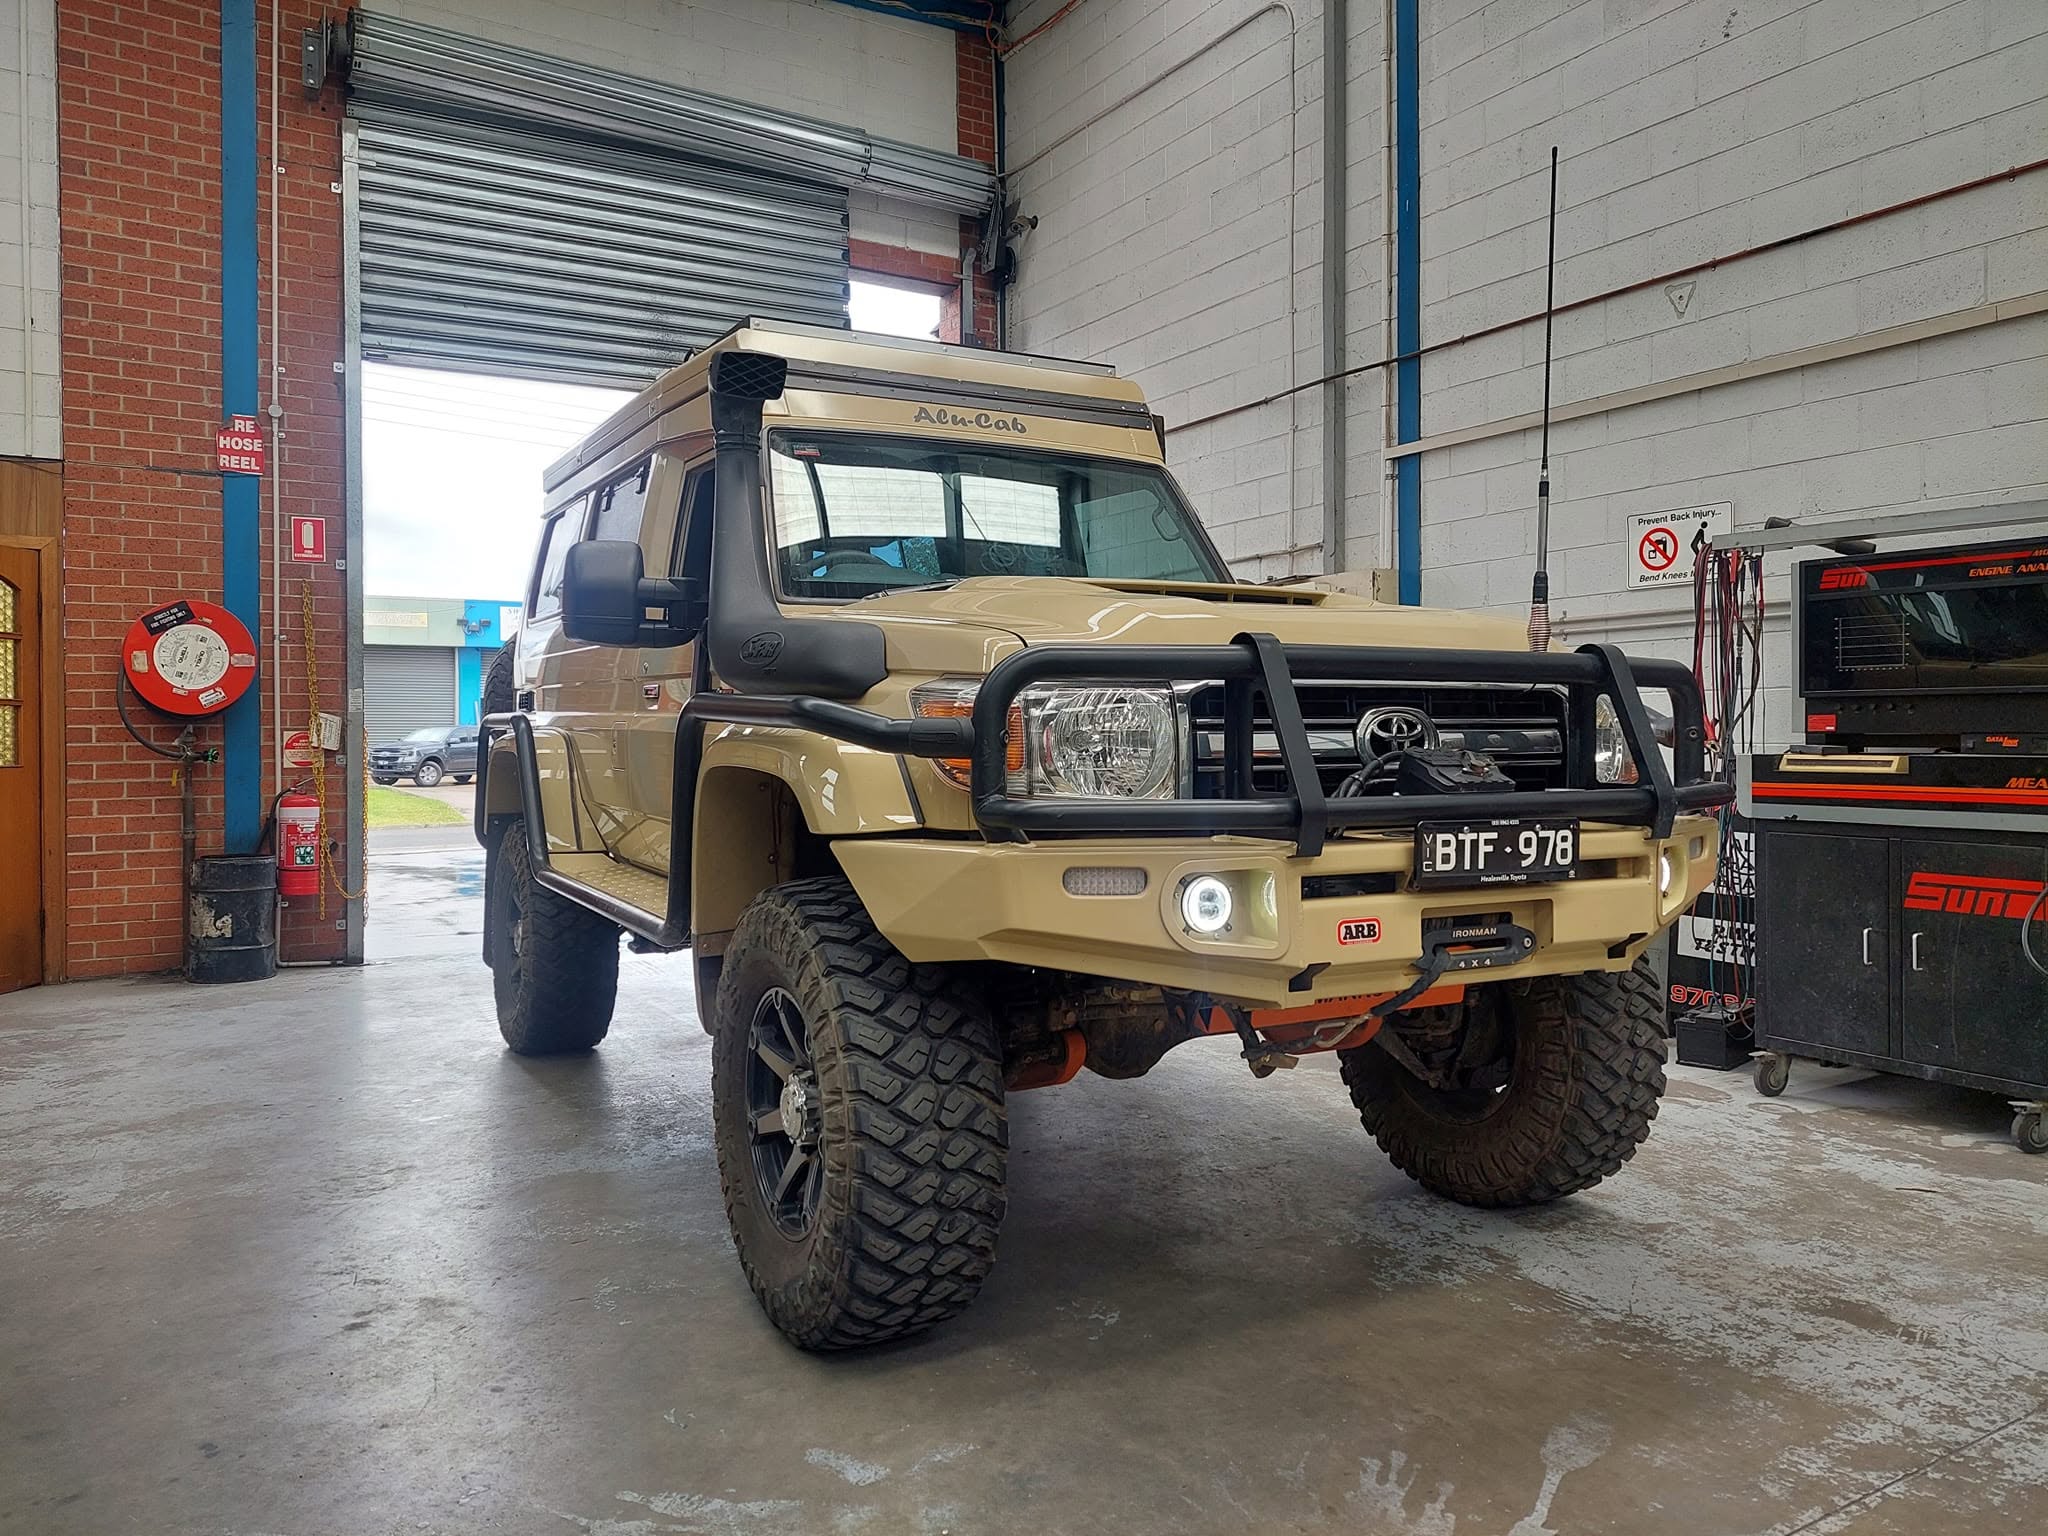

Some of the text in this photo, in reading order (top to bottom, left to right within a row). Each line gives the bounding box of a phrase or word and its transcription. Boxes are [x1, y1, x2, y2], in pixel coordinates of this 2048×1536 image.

[914, 406, 1027, 433] Alu-Cab
[219, 436, 263, 452] HOSE
[219, 454, 260, 470] REEL
[1638, 516, 1668, 526] Prevent
[1670, 512, 1690, 521] Back
[1639, 574, 1660, 583] Bend
[1661, 571, 1688, 580] Knees
[1969, 565, 2014, 577] ENGINE
[1435, 829, 1573, 871] BTF 978
[1342, 923, 1378, 941] ARB
[1452, 926, 1498, 939] IRONMAN
